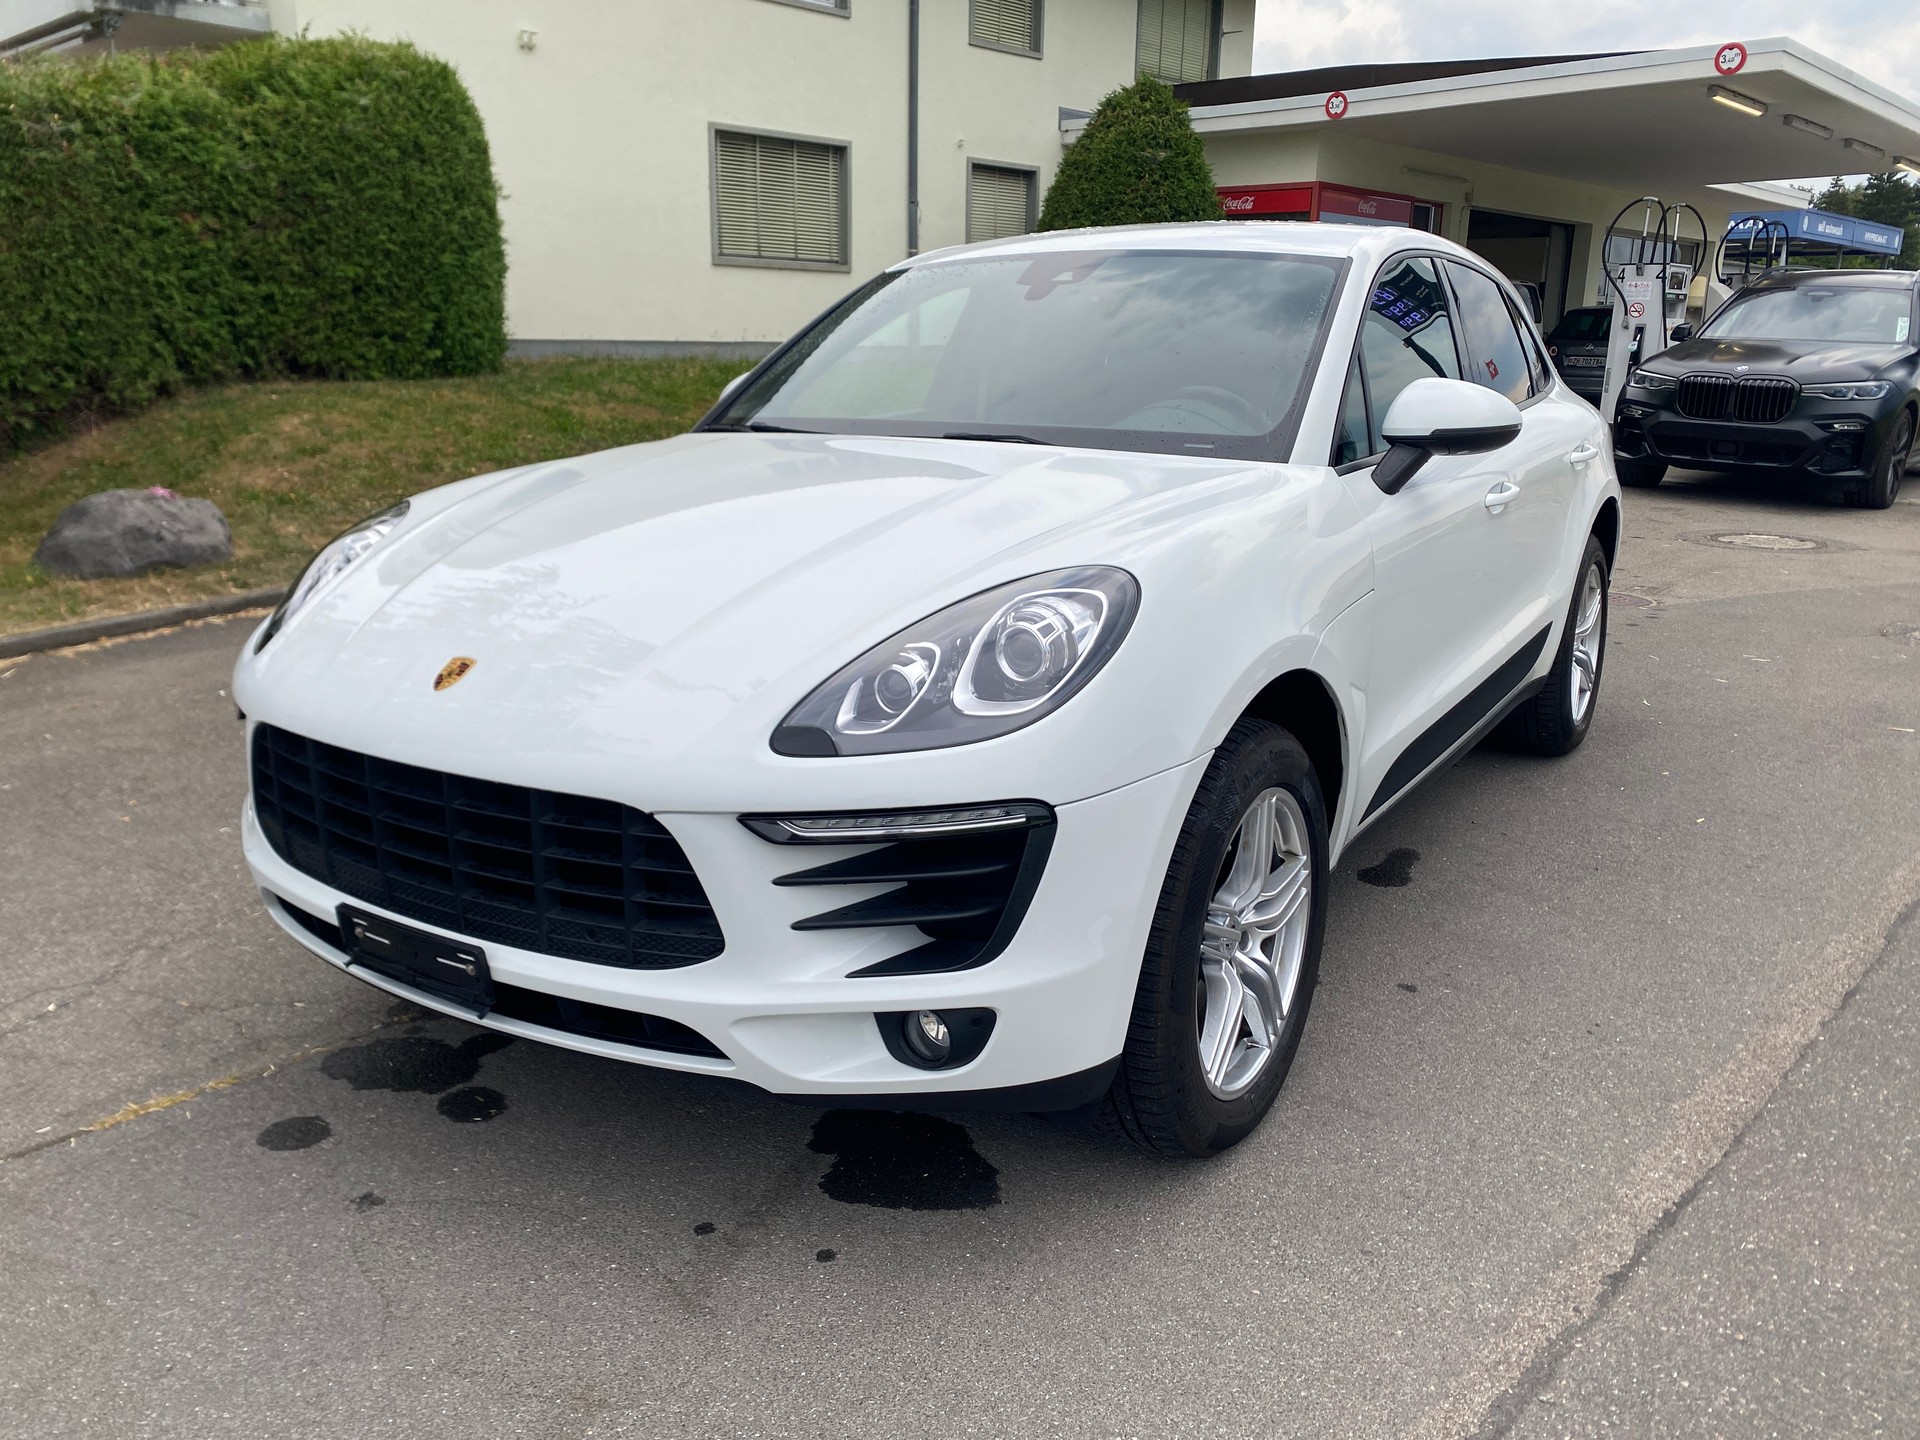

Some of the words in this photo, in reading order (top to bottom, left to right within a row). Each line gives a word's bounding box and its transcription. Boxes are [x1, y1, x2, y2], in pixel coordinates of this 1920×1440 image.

[1223, 196, 1255, 210] Coca-Cola
[1618, 267, 1625, 283] 4
[1655, 268, 1667, 283] 4
